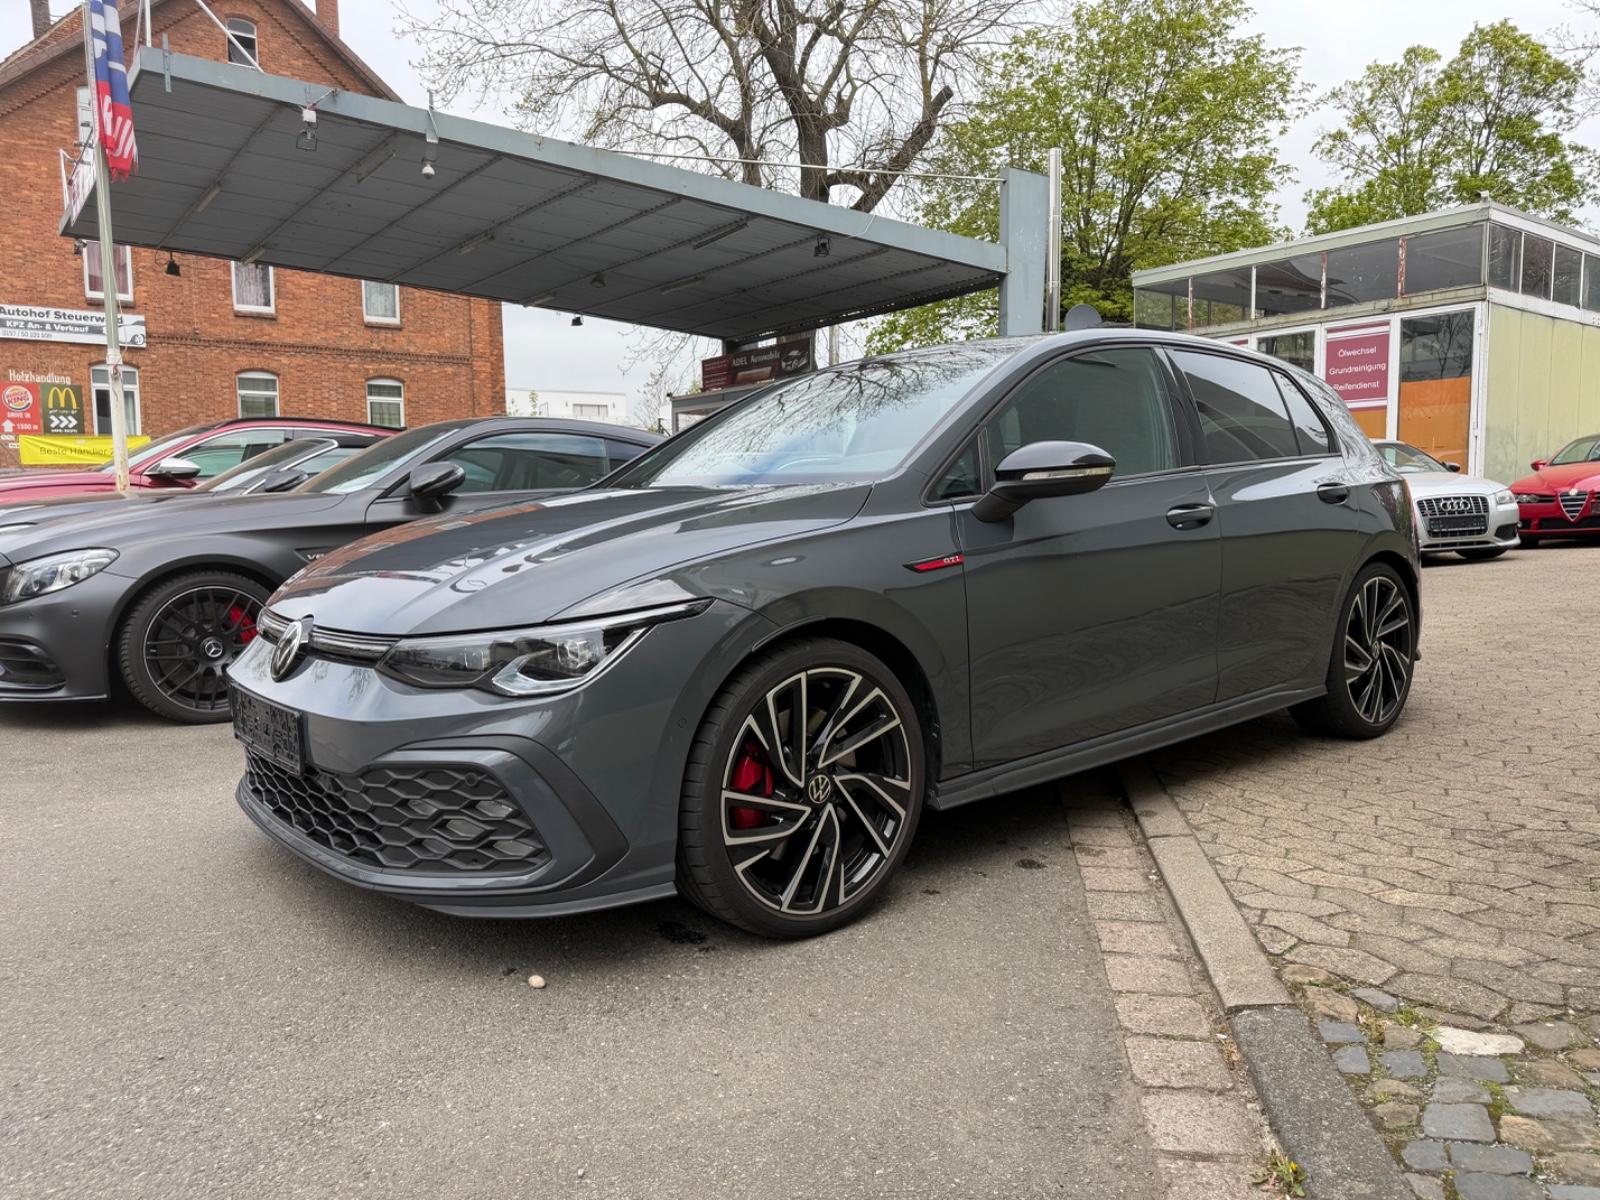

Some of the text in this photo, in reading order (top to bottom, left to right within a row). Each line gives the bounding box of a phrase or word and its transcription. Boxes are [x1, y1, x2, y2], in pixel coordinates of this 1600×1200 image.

[0, 306, 124, 325] Autohof Steuerwd
[6, 320, 90, 334] KFZ An- & Verkauf
[1338, 346, 1377, 357] Ölwechsel
[1329, 363, 1386, 375] Grundreinigung
[9, 369, 71, 384] Holzhandlung
[1333, 380, 1379, 391] Reifendienst
[943, 555, 960, 564] GTI
